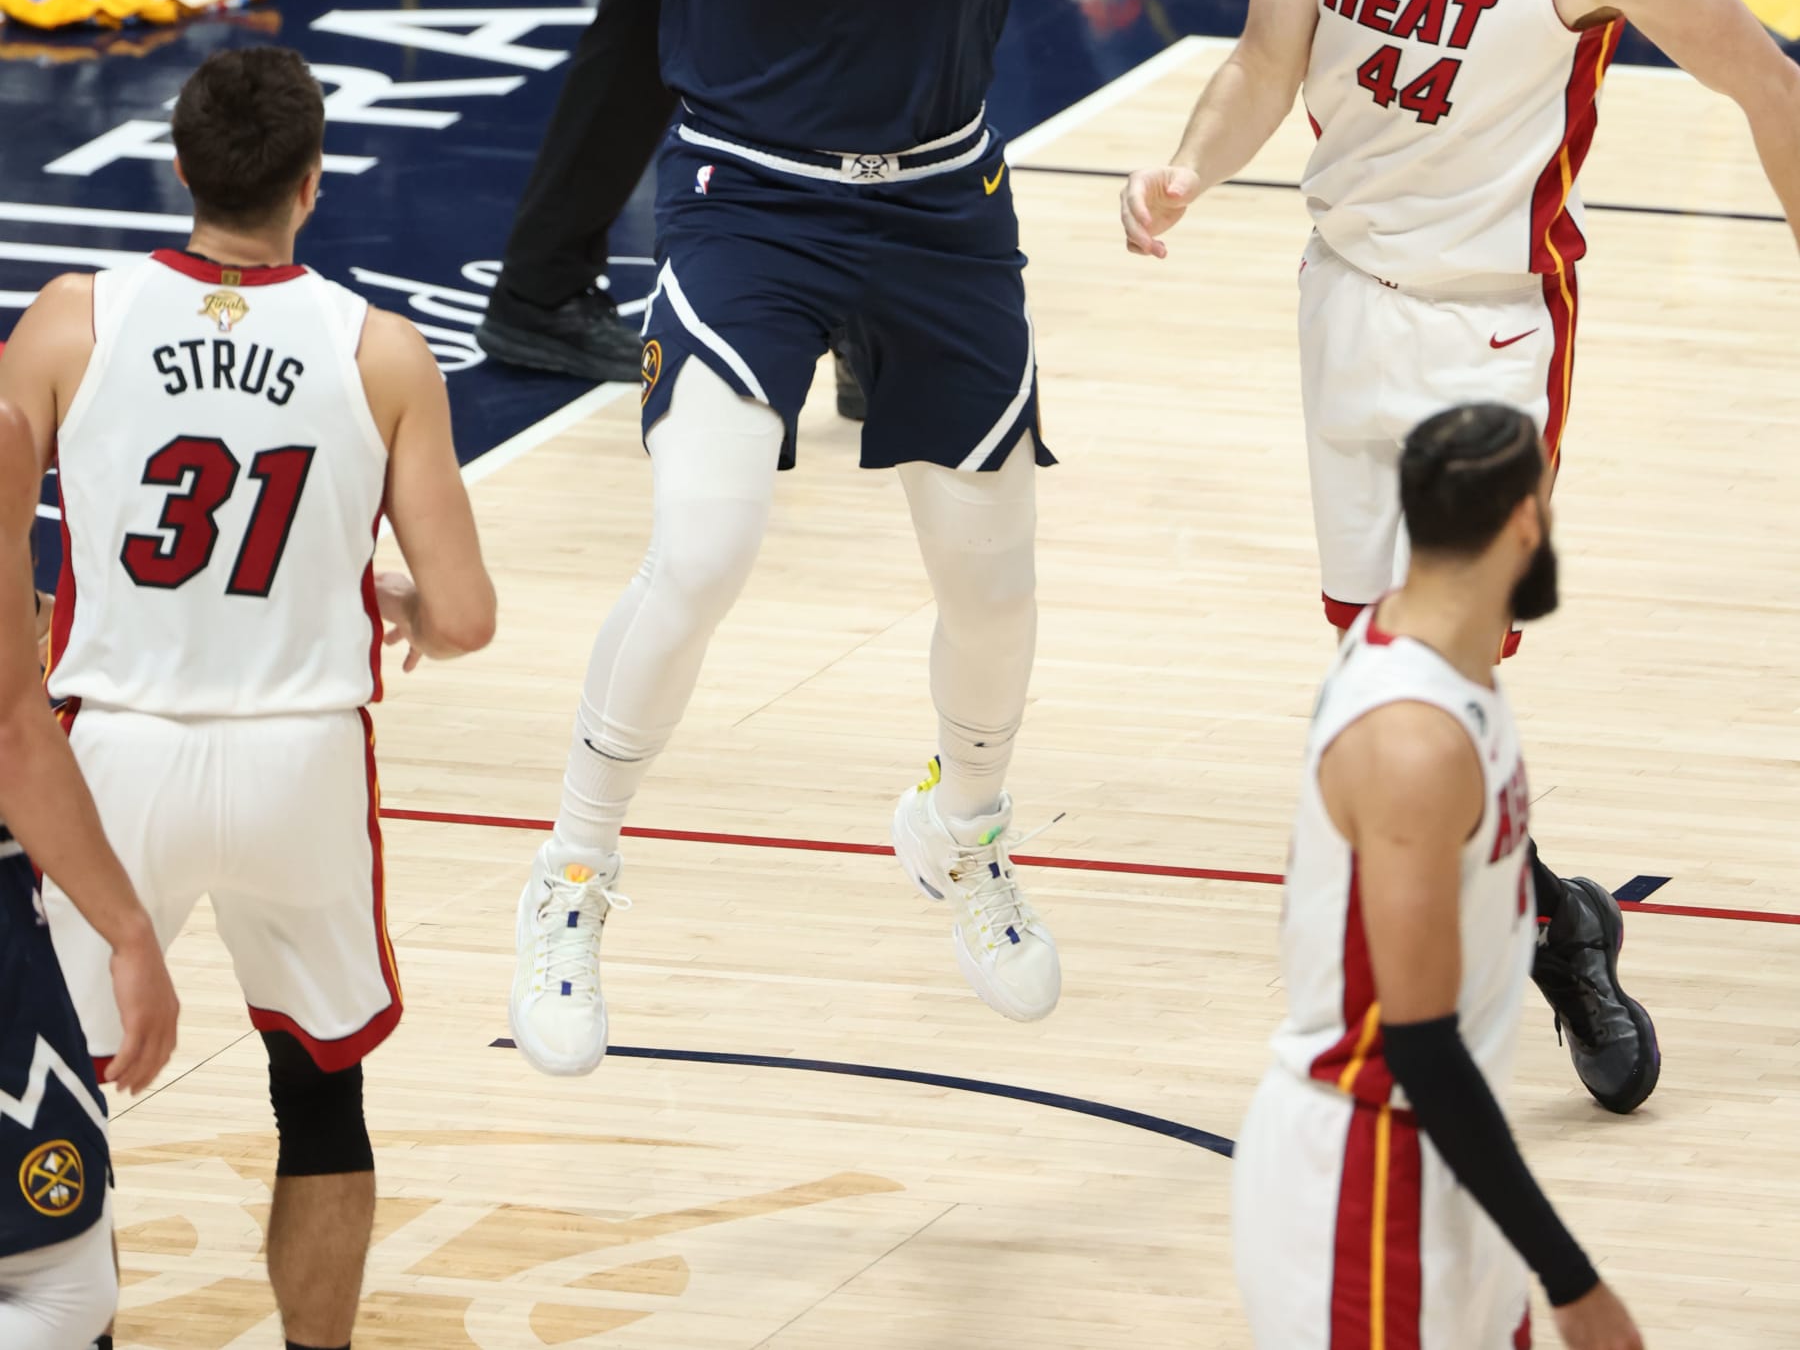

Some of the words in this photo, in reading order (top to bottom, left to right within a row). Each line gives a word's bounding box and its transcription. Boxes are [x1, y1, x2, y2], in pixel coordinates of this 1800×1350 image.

[1357, 44, 1463, 126] 44
[198, 293, 249, 315] Finals
[152, 338, 304, 406] STRUS
[119, 434, 317, 598] 31
